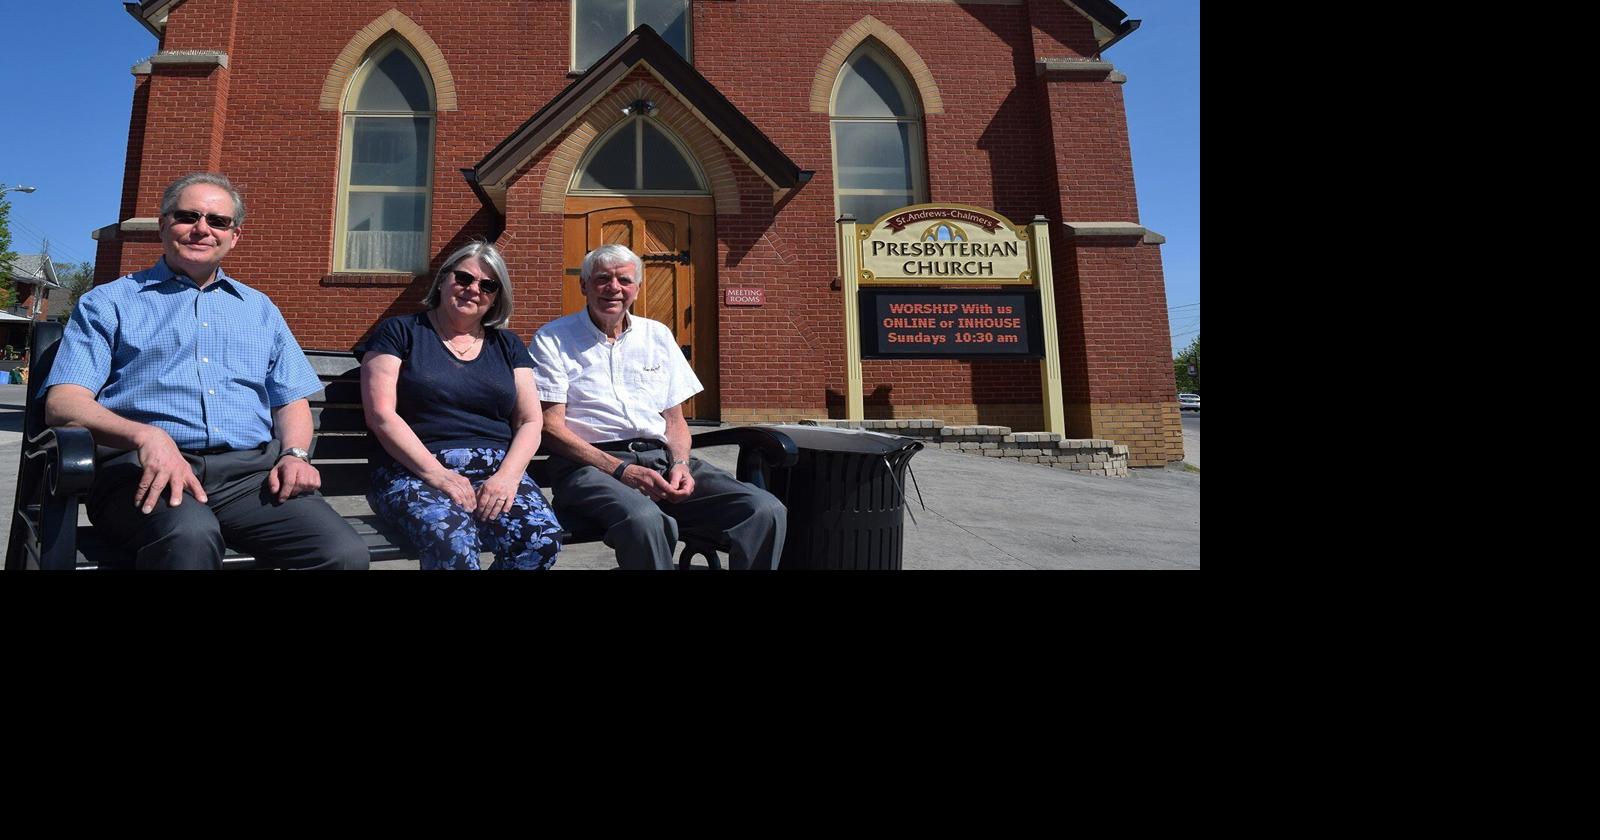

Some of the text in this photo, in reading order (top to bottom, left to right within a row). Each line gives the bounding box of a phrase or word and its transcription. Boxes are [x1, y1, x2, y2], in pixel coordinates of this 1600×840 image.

[872, 240, 1018, 257] PRESBYTERIAN
[902, 260, 993, 276] CHURCH
[889, 303, 1013, 314] WORSHIP With us
[883, 317, 1021, 329] ONLINE or INHOUSE
[887, 332, 1019, 345] Sundays 10:30 am
